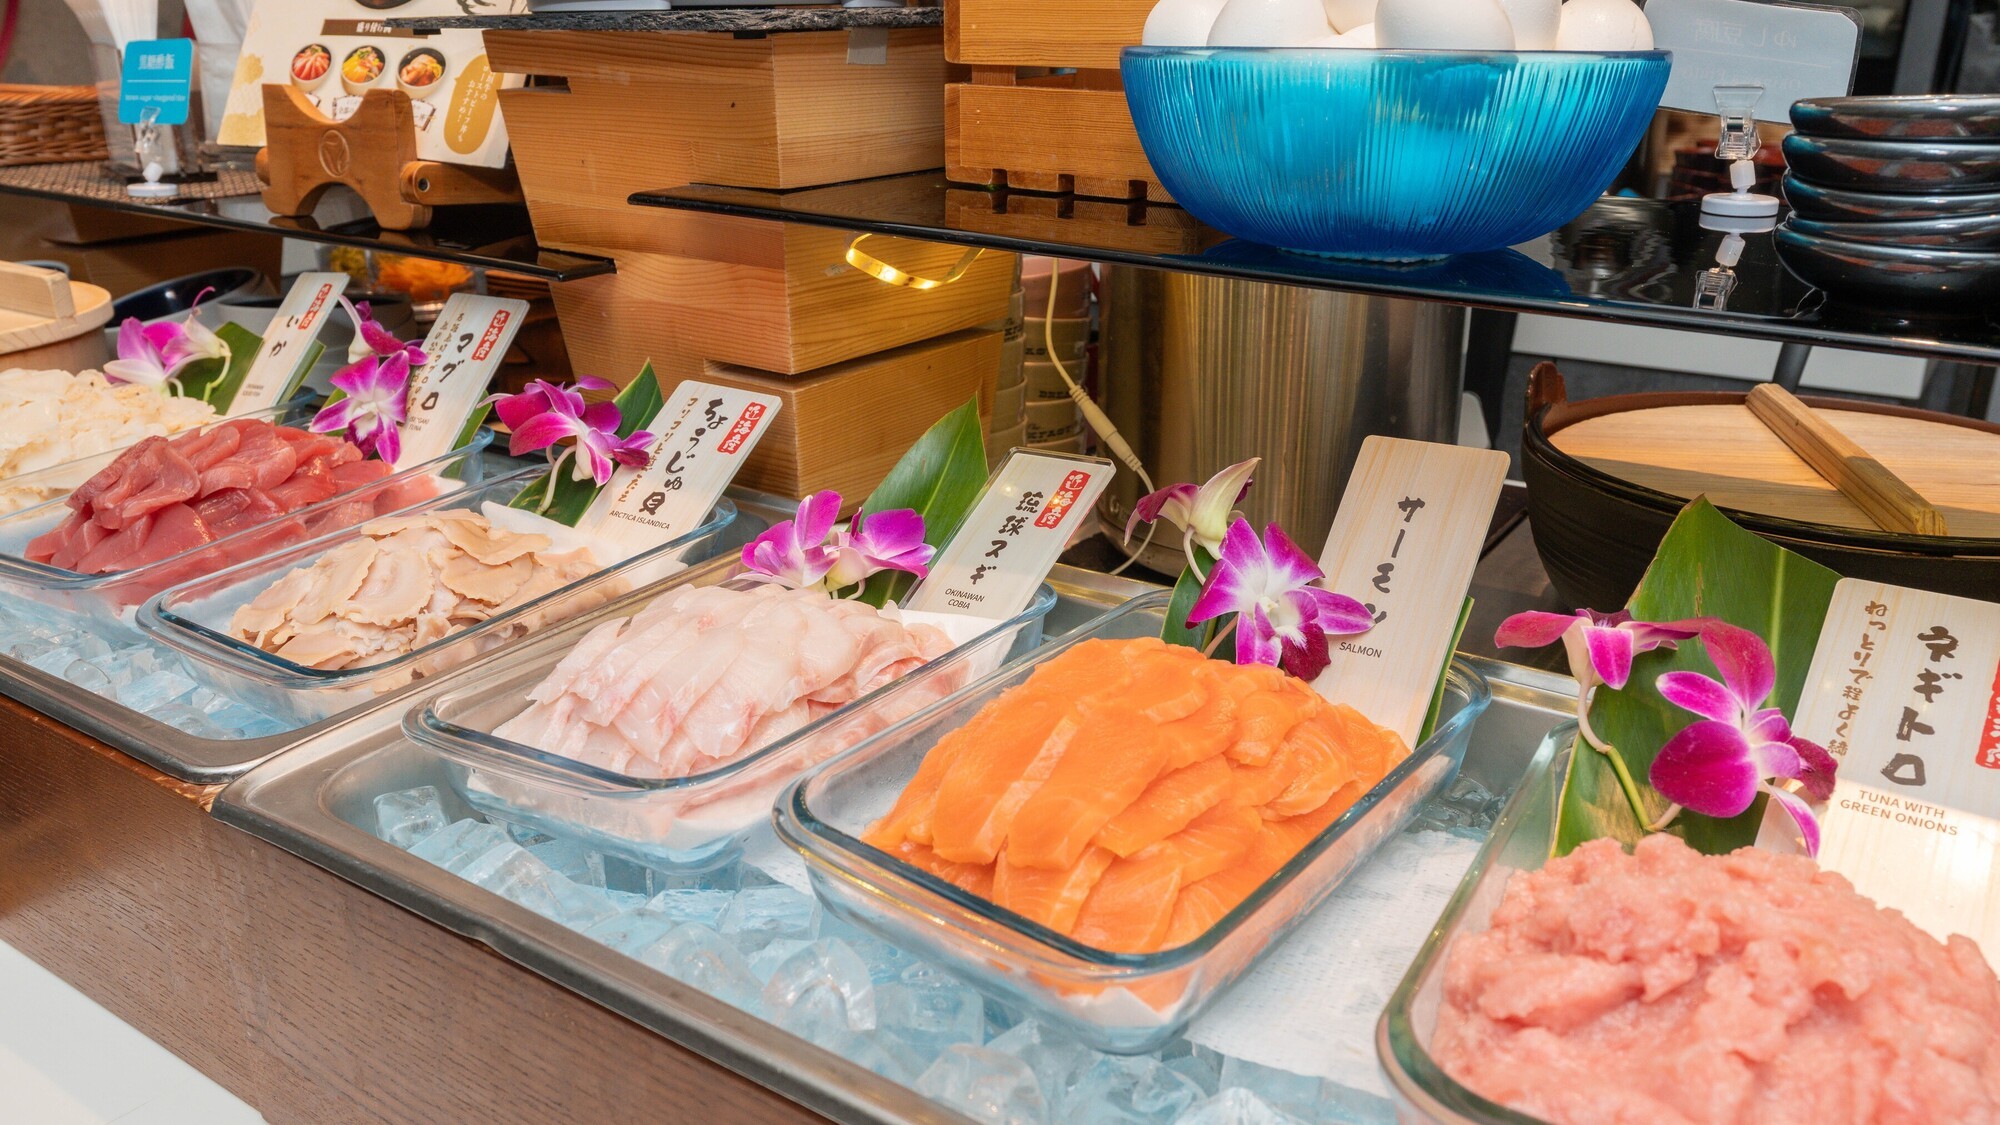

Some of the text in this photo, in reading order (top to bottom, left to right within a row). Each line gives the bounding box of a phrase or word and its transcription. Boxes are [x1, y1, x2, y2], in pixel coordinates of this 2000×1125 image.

[269, 315, 299, 358] いか
[421, 333, 474, 410] マグロ
[722, 405, 760, 452] 近海産
[639, 398, 728, 515] ちょうじゅ貝
[609, 510, 670, 530] ARCTICA ISLANDICA
[1043, 474, 1085, 526] 近海産
[970, 491, 1044, 585] 琉球スギ
[945, 588, 985, 602] OKINAWAN
[947, 598, 971, 609] COBIA
[1339, 641, 1383, 658] SALMON
[1880, 626, 1963, 786] ネギトロ
[1840, 799, 1958, 836] GREEN ONIONS
[1859, 790, 1945, 819] TUNA WITH
